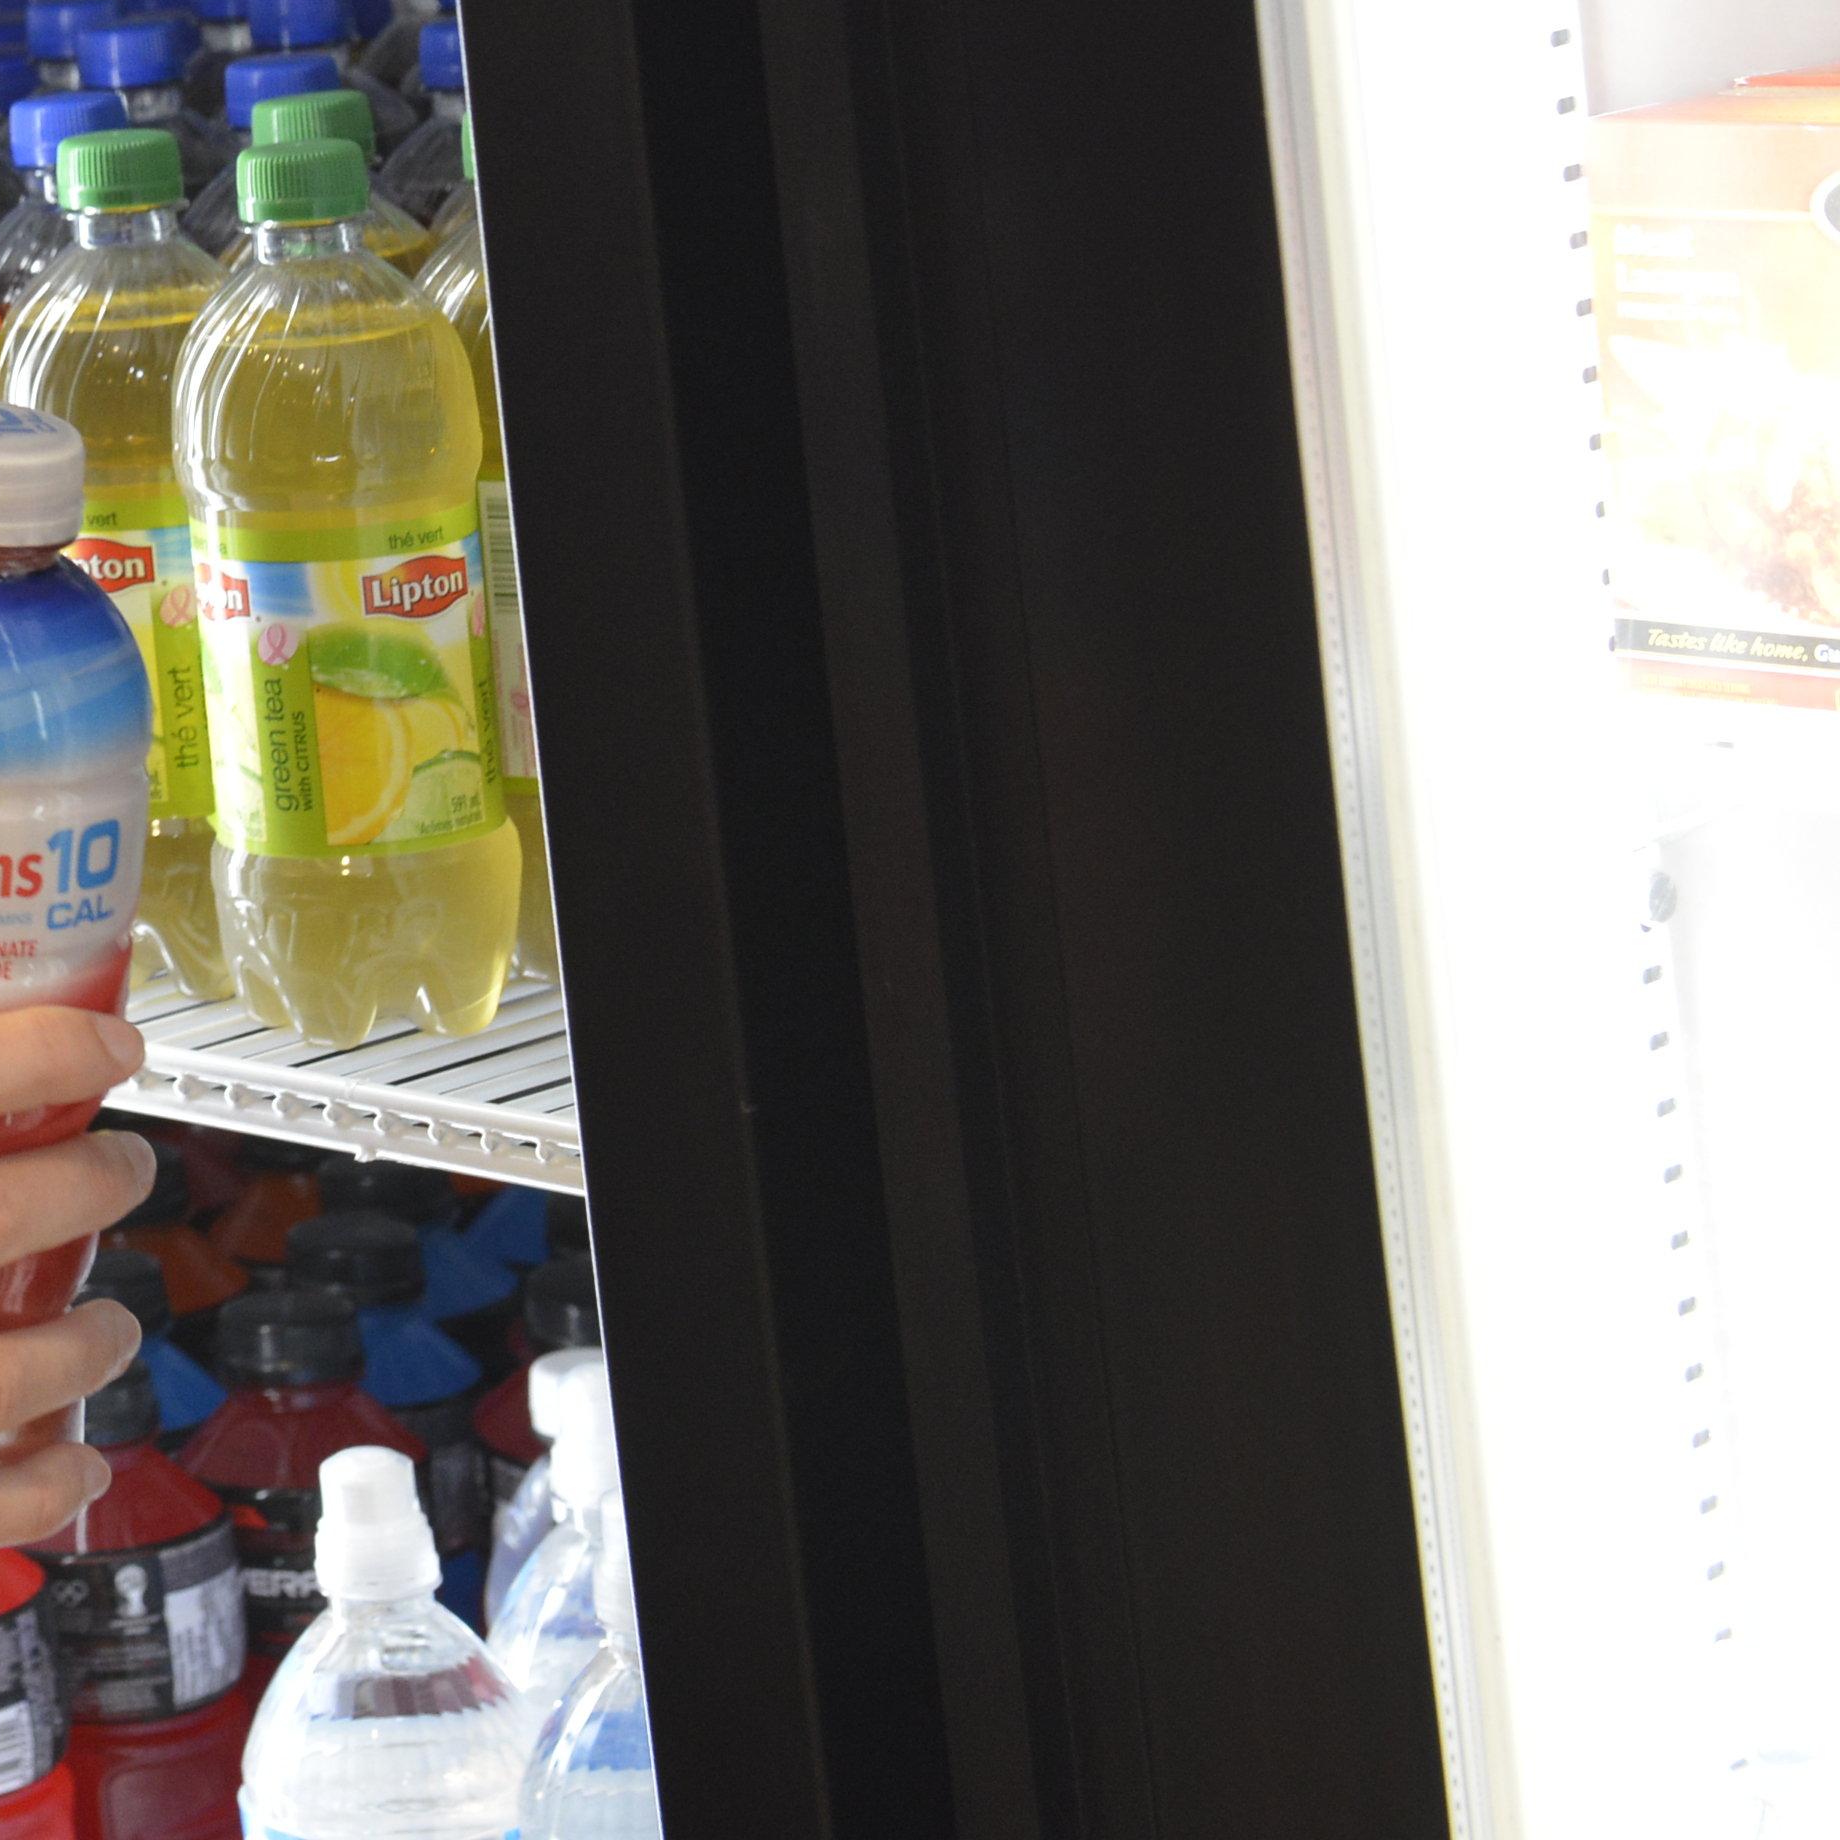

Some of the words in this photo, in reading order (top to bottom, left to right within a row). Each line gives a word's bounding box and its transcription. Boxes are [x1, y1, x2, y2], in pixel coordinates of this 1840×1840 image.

[418, 527, 443, 544] vert
[75, 554, 146, 580] ton
[372, 571, 464, 612] Lipton
[1648, 628, 1707, 651] Tastes
[1710, 632, 1748, 654] like
[1751, 636, 1808, 662] home.
[169, 666, 193, 720] vert
[264, 677, 283, 722] tea
[175, 725, 199, 770] thé
[293, 711, 308, 772] CITRUS
[270, 730, 298, 812] green
[300, 776, 312, 811] with
[47, 819, 120, 894] 10
[47, 895, 114, 930] CAL
